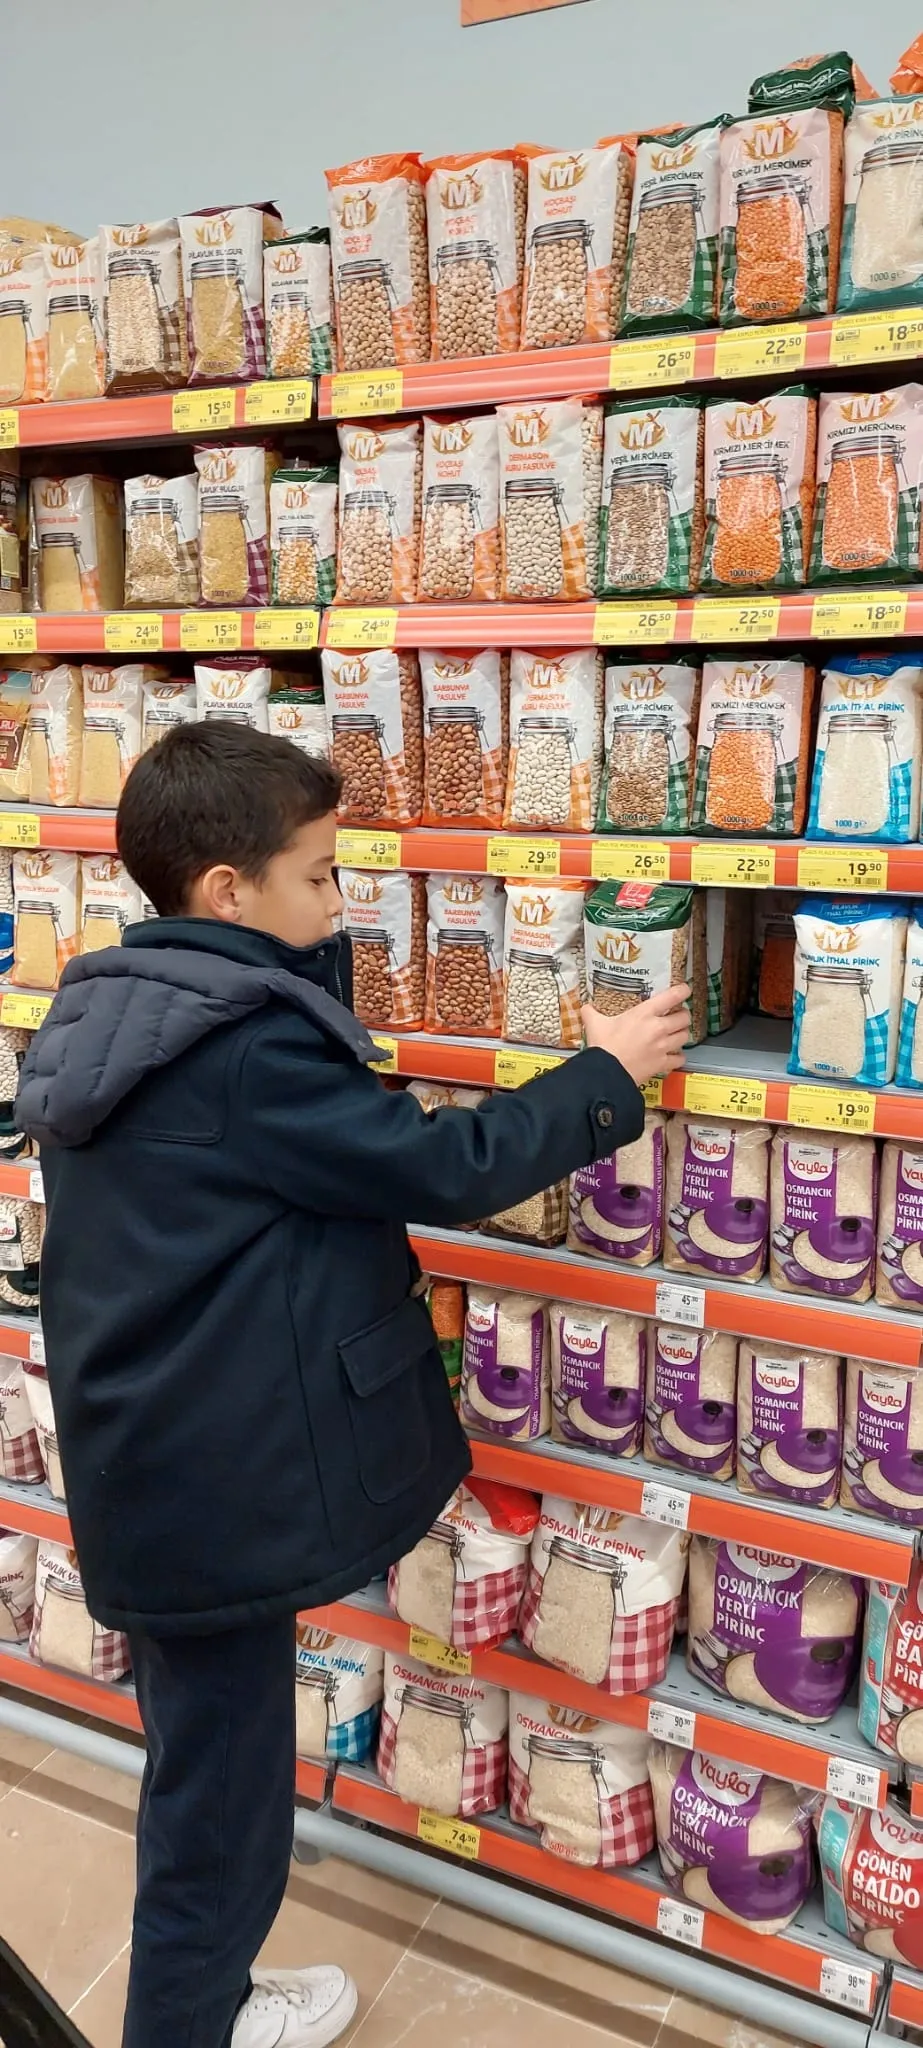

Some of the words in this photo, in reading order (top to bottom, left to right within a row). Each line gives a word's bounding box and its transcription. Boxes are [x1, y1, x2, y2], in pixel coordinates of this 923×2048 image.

[877, 702, 905, 712] PİRİNÇ
[827, 955, 849, 965] İTHAL
[853, 957, 880, 967] PİRİNÇ
[609, 966, 649, 975] MERCİMEK
[692, 1140, 726, 1156] Yayla
[685, 1163, 729, 1178] OSMANCIK
[790, 1159, 828, 1175] Yayla
[685, 1174, 709, 1187] YERLİ
[684, 1185, 714, 1201] PİRİNÇ
[786, 1184, 832, 1198] OSMANCIK
[786, 1195, 812, 1208] YERLİ
[786, 1206, 818, 1223] PİRİNÇ
[566, 1335, 598, 1350] Yayla
[660, 1343, 693, 1359] Yayla
[562, 1365, 583, 1378] YERLİ
[656, 1365, 696, 1381] OSMANCIK
[561, 1376, 589, 1390] PİRİNÇ
[656, 1377, 677, 1389] YERLİ
[759, 1373, 796, 1388] Yayla
[656, 1387, 683, 1402] PİRİNÇ
[865, 1389, 902, 1408] Yayla
[754, 1396, 799, 1410] OSMANCIK
[754, 1407, 779, 1419] YERLİ
[859, 1411, 904, 1430] OSMANCIK
[754, 1418, 785, 1434] PİRİNÇ
[859, 1421, 884, 1439] YERLİ
[858, 1433, 890, 1453] PİRİNÇ
[604, 1539, 646, 1561] PİRİNÇ
[718, 1575, 799, 1609] OSMANCIK
[718, 1593, 756, 1620] YERLİ
[717, 1612, 765, 1643] PİRİNÇ
[393, 1665, 447, 1694] OSMANCIK
[700, 1756, 750, 1798] Yayla
[672, 1806, 706, 1837] YERLİ
[672, 1826, 715, 1859] PİRİNÇ
[857, 1849, 912, 1882] GÖNEN
[852, 1869, 920, 1908] BALDO
[852, 1890, 904, 1924] PİRİNÇ
